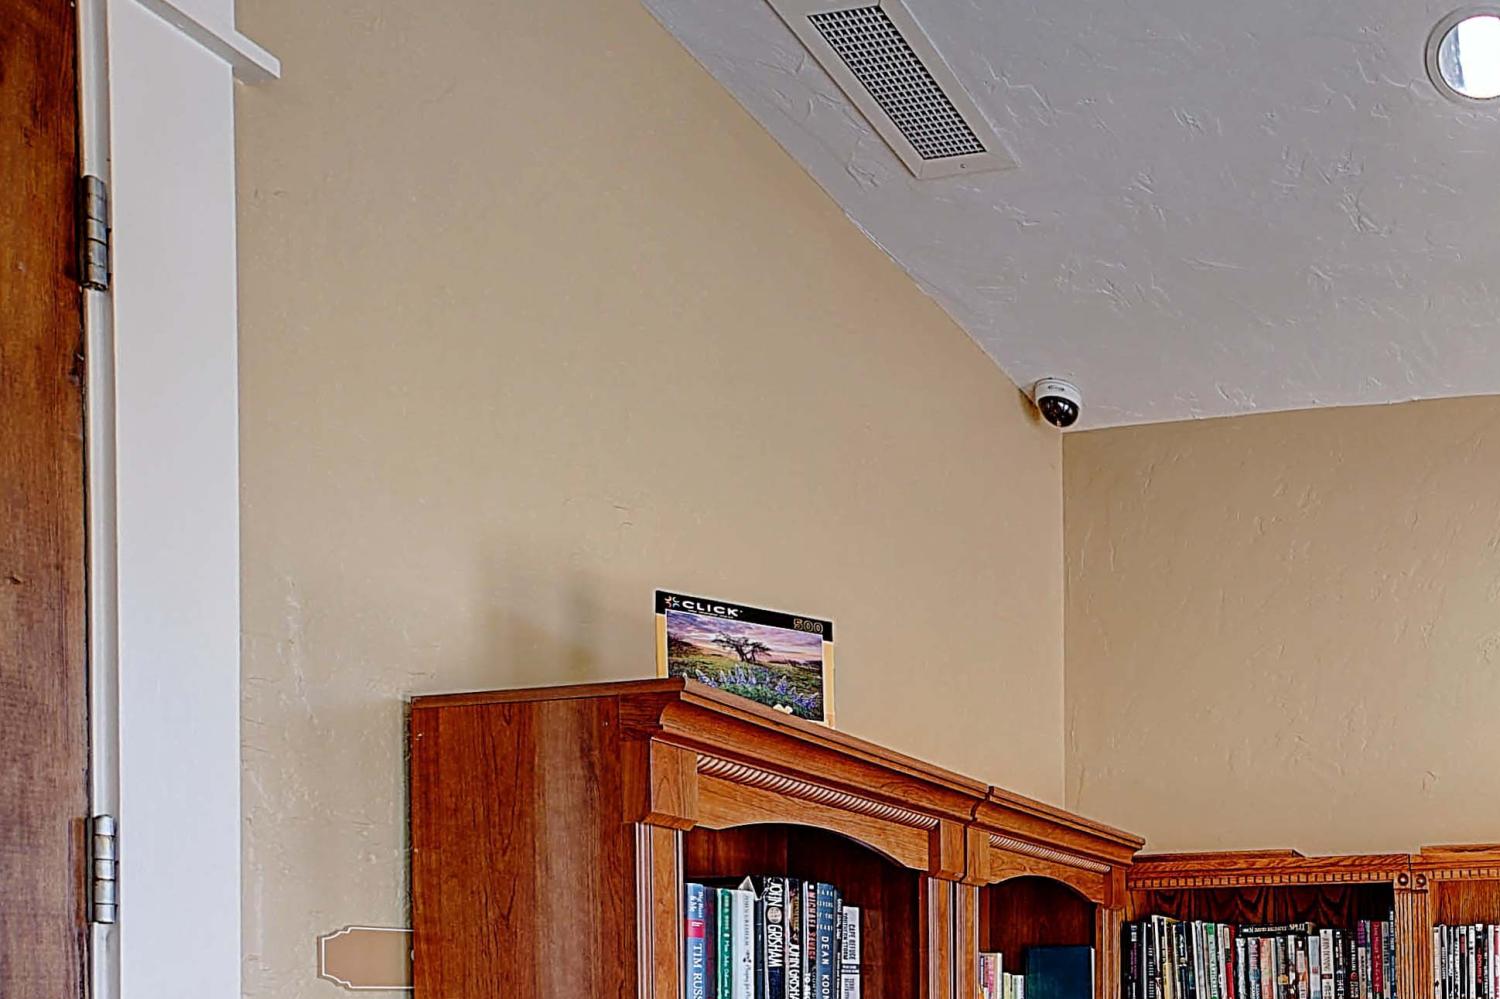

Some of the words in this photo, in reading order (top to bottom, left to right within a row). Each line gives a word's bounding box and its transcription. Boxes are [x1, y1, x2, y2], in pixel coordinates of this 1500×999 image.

[682, 600, 739, 617] CLICK
[768, 882, 783, 907] JOHN
[693, 943, 703, 968] TIM
[768, 924, 783, 968] GRISHAM
[789, 943, 800, 968] JOHN
